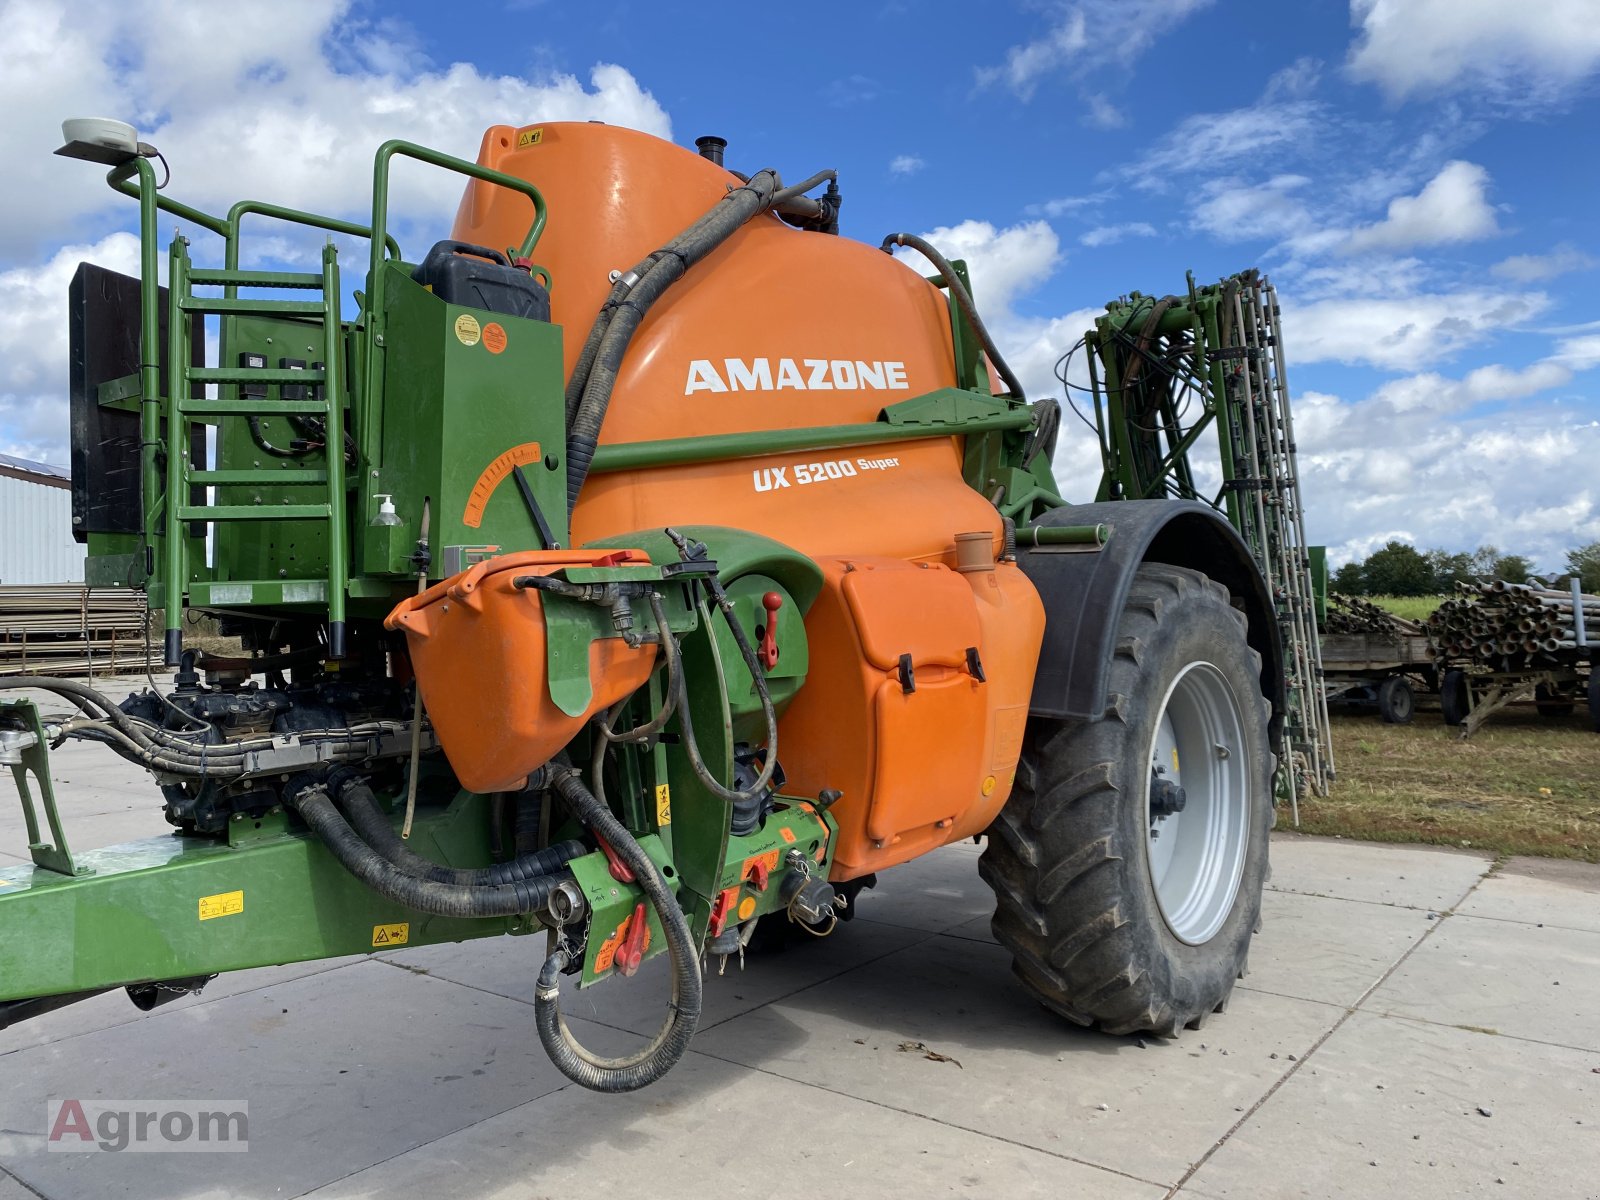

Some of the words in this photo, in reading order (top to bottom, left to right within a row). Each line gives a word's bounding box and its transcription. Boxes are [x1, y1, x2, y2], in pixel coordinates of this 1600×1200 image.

[684, 358, 909, 395] AMAZONE
[753, 467, 791, 492] UX
[794, 460, 857, 484] 5200
[857, 457, 899, 470] Super
